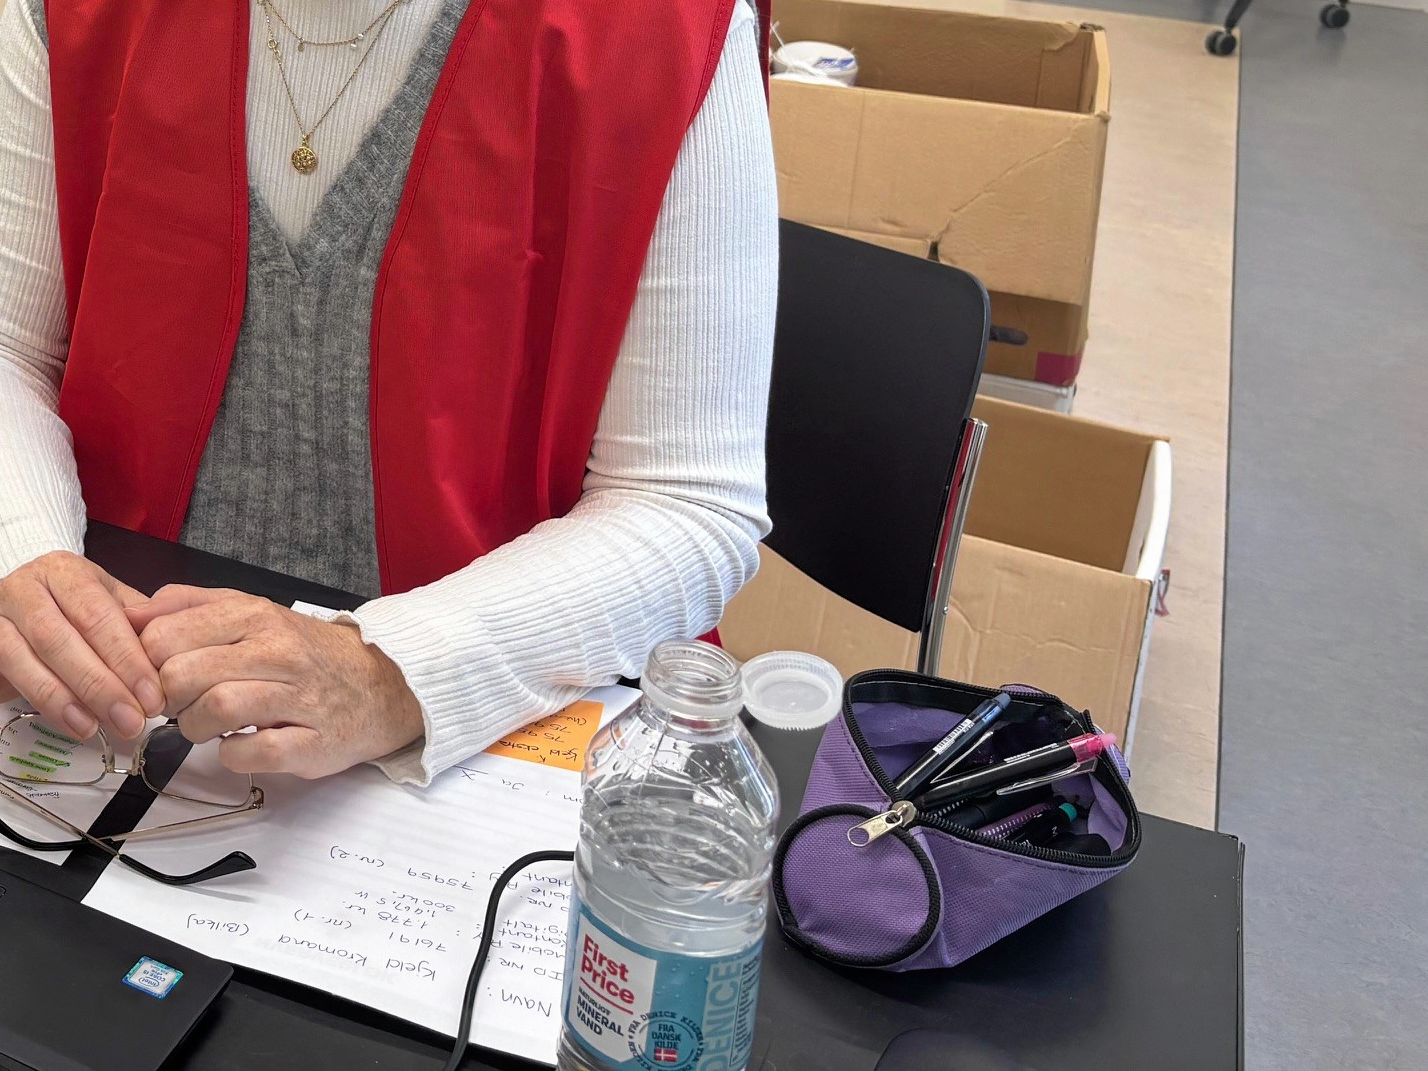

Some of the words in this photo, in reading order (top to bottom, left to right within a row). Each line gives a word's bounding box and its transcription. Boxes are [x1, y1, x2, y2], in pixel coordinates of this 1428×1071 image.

[407, 868, 474, 891] 75959
[531, 886, 571, 900] obile
[503, 919, 569, 937] igitalt
[584, 933, 629, 983] First
[386, 958, 436, 982] Kjeld
[581, 954, 635, 1004] Price
[576, 1005, 603, 1036] VAND
[577, 994, 625, 1037] MINERAL
[652, 1032, 682, 1042] DANSK
[658, 1023, 675, 1032] FRA
